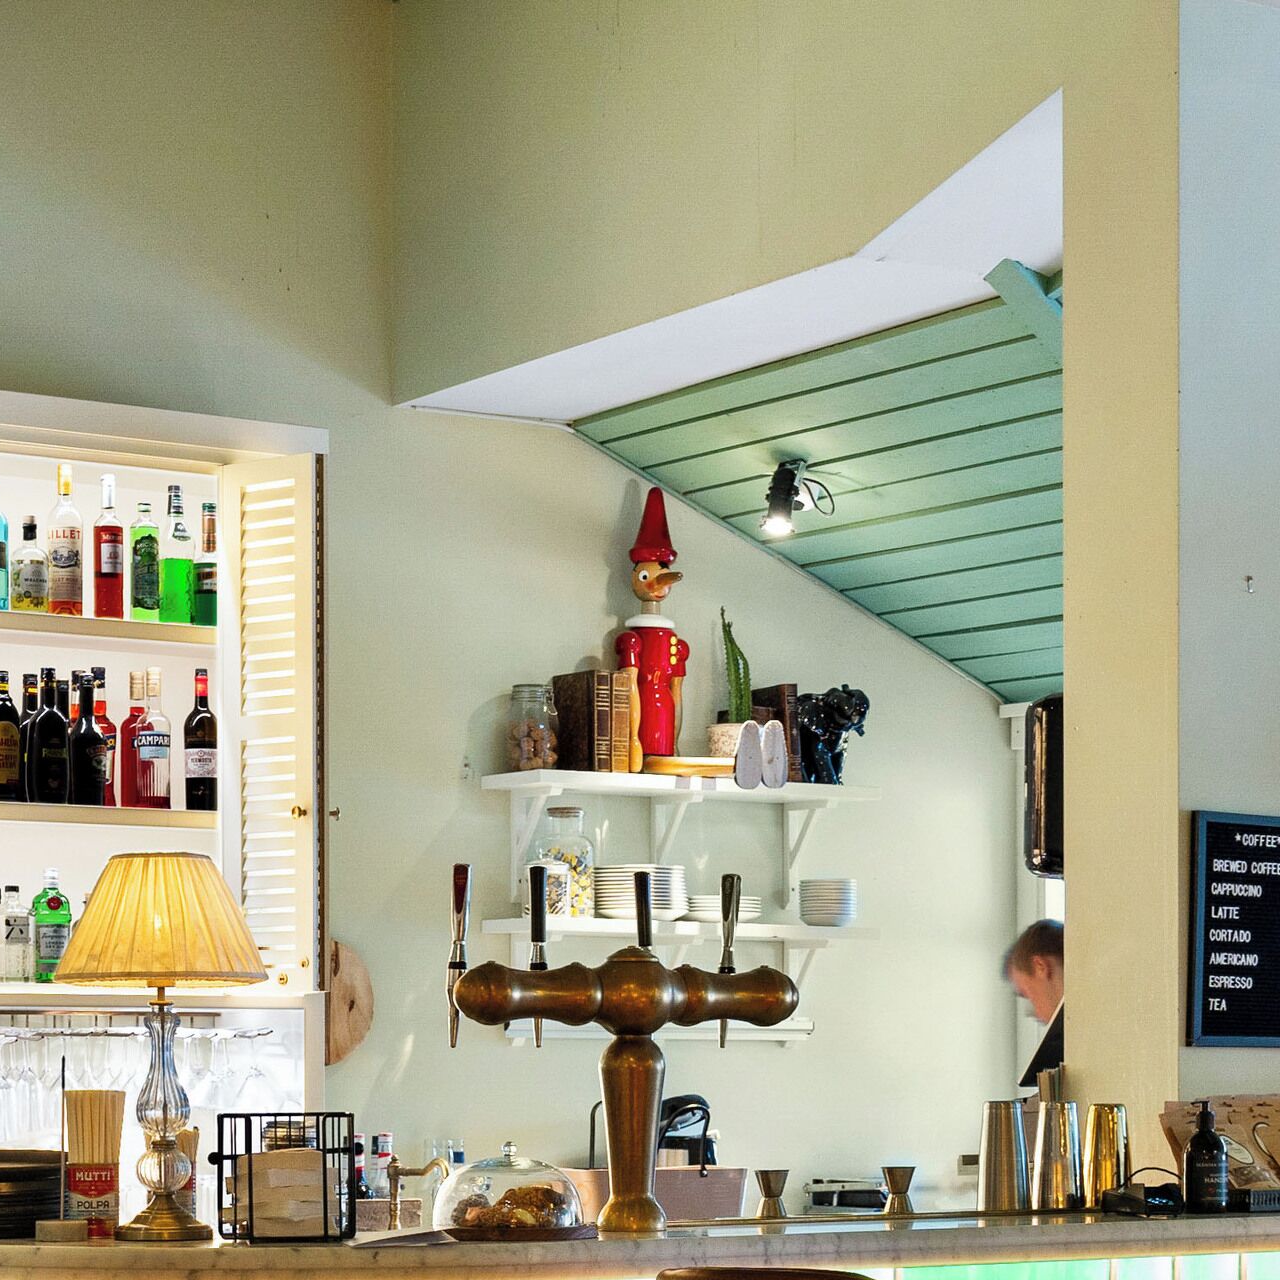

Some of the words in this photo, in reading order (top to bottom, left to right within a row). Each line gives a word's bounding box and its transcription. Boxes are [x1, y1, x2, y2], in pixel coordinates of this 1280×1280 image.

[48, 528, 81, 540] ILLET
[1212, 858, 1248, 873] BREWED
[1211, 882, 1263, 898] CAPPUCCINO
[1211, 905, 1240, 920] LATTE
[1209, 928, 1252, 943] CORTADO
[1209, 952, 1259, 966] AMERICANO
[1208, 975, 1253, 989] ESPRESSO
[1208, 998, 1227, 1011] TEA
[75, 1171, 111, 1182] MUTTI
[76, 1200, 110, 1210] POLPA
